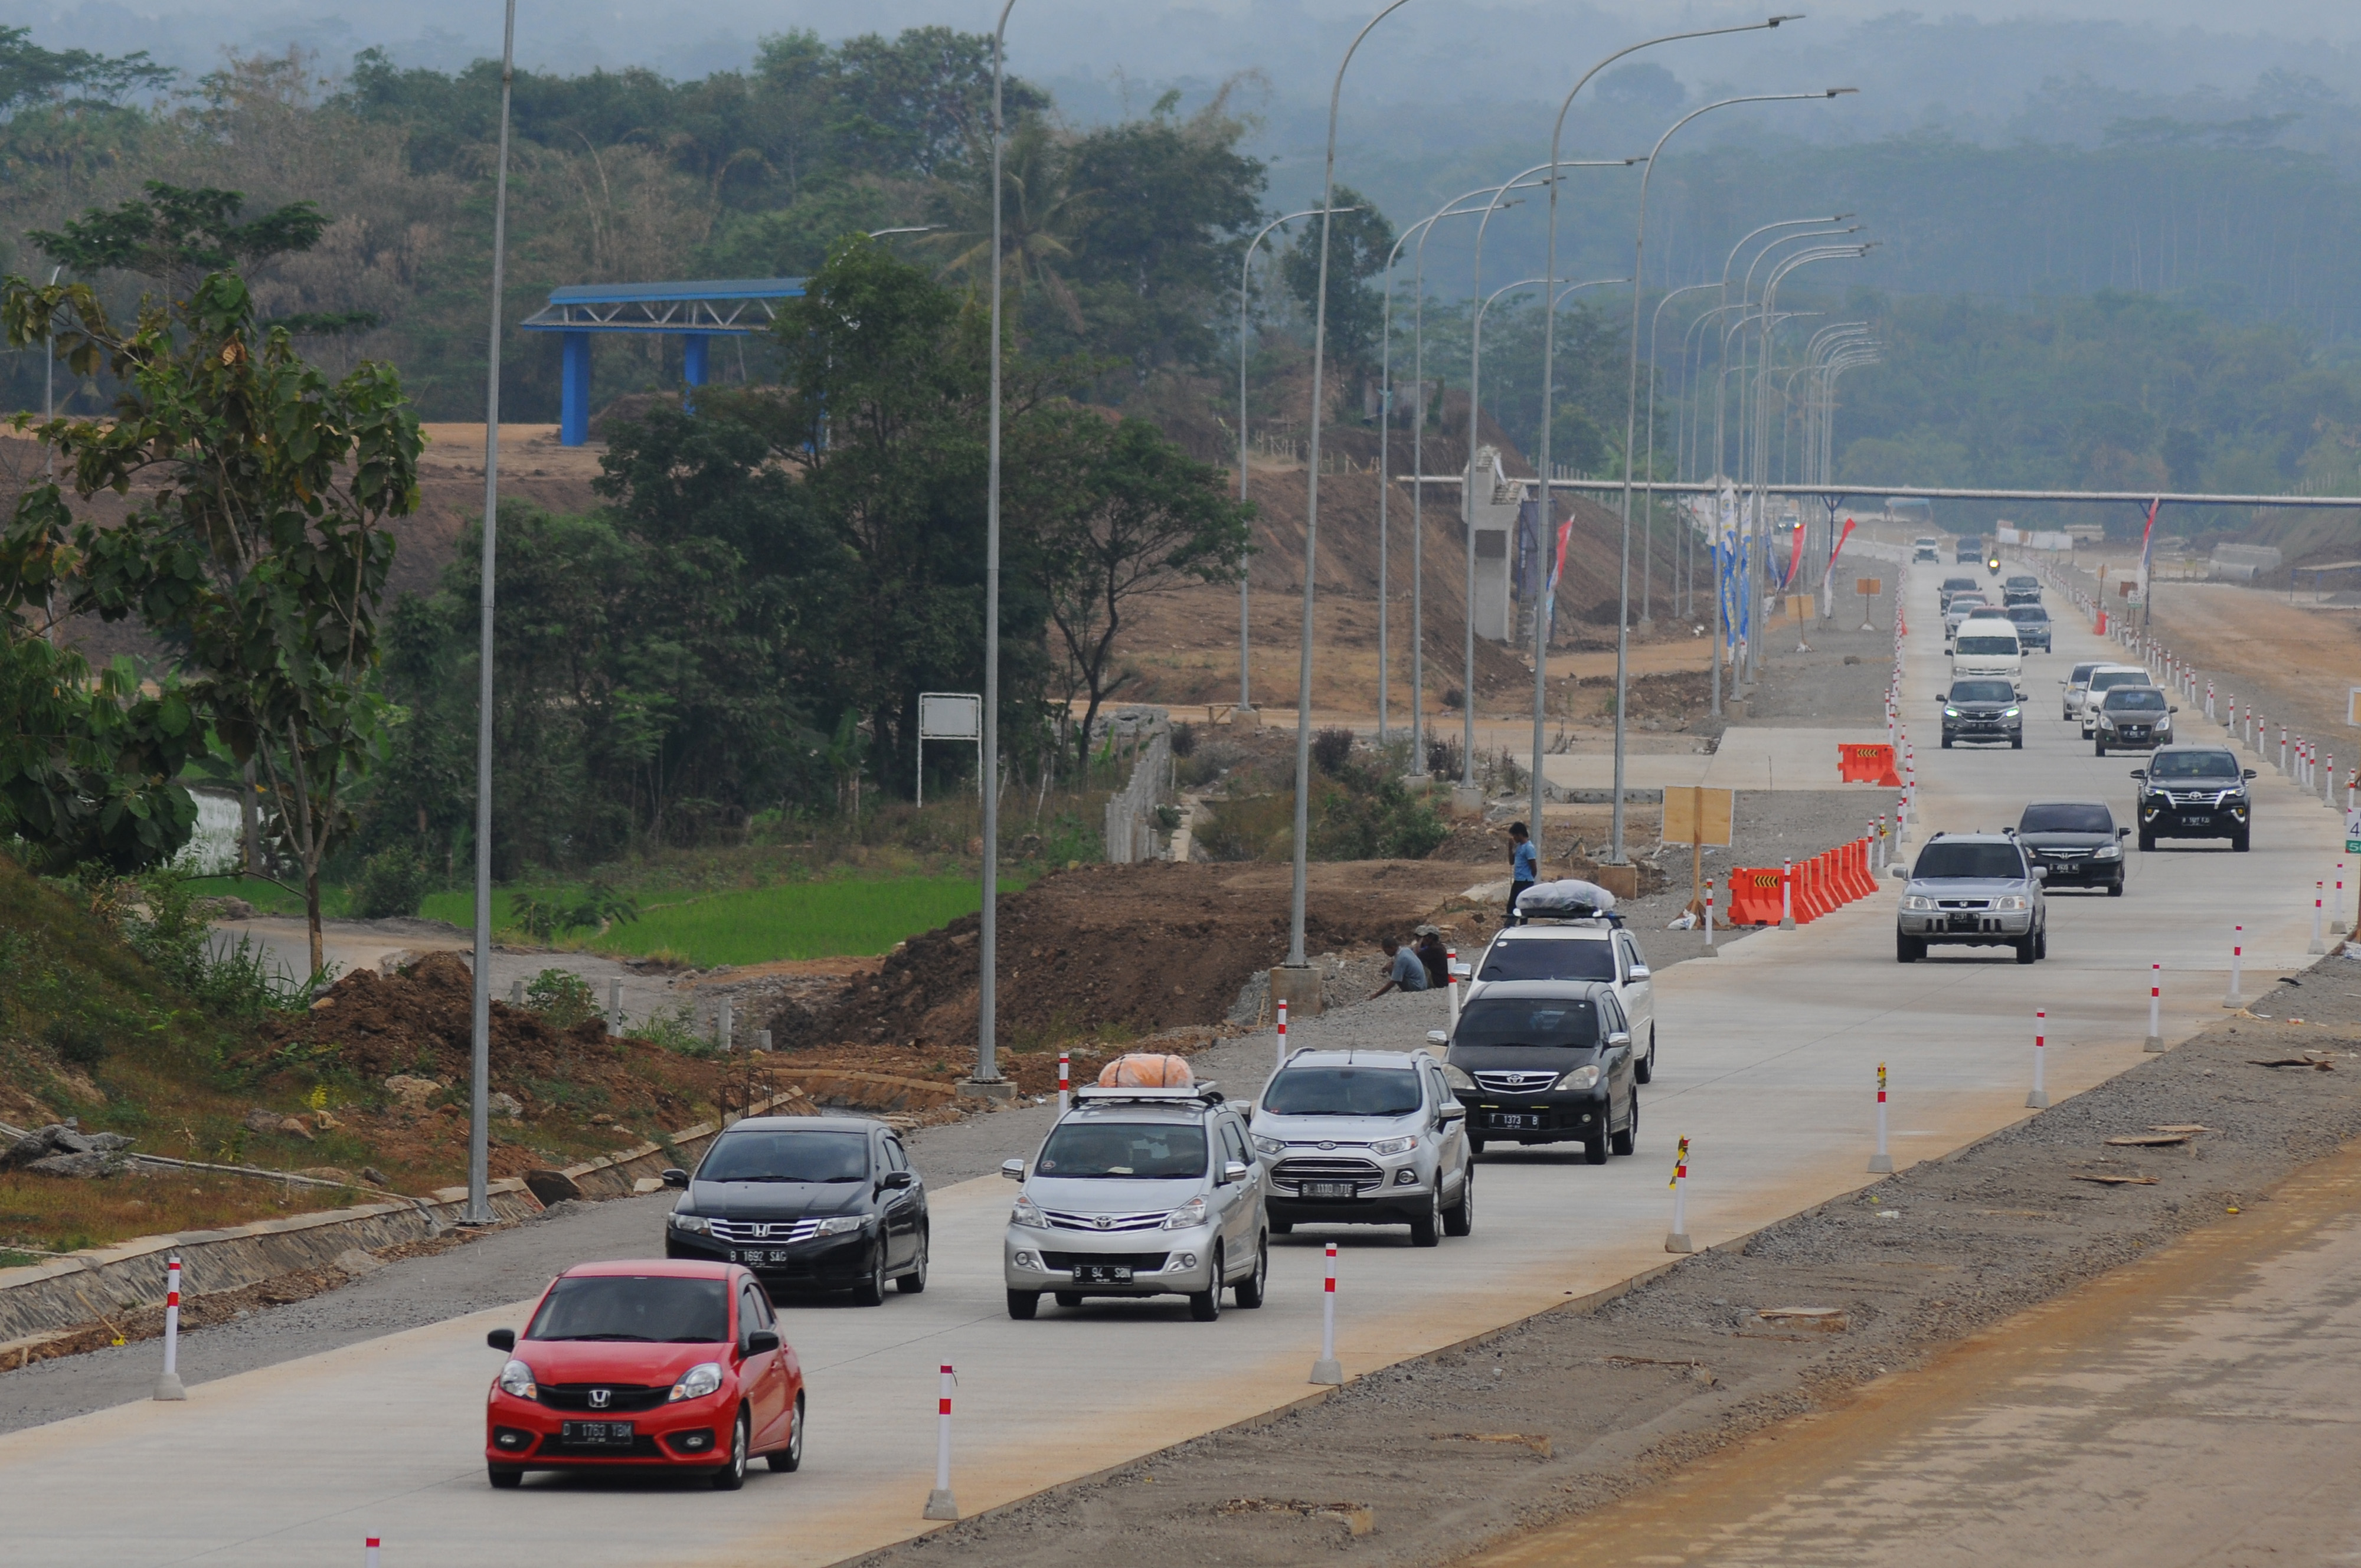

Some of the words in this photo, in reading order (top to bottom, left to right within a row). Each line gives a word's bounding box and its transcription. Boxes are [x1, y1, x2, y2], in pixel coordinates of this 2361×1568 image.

[1492, 1115, 1496, 1123] T
[1504, 1115, 1521, 1124] 1373
[1532, 1116, 1538, 1125] B
[1303, 1184, 1308, 1193] B
[1317, 1184, 1333, 1193] 1110
[731, 1251, 737, 1261] B
[744, 1251, 764, 1261] 1692
[770, 1251, 787, 1261] SAG
[1075, 1267, 1081, 1277] B
[563, 1423, 570, 1435] D
[582, 1424, 606, 1436] 1763
